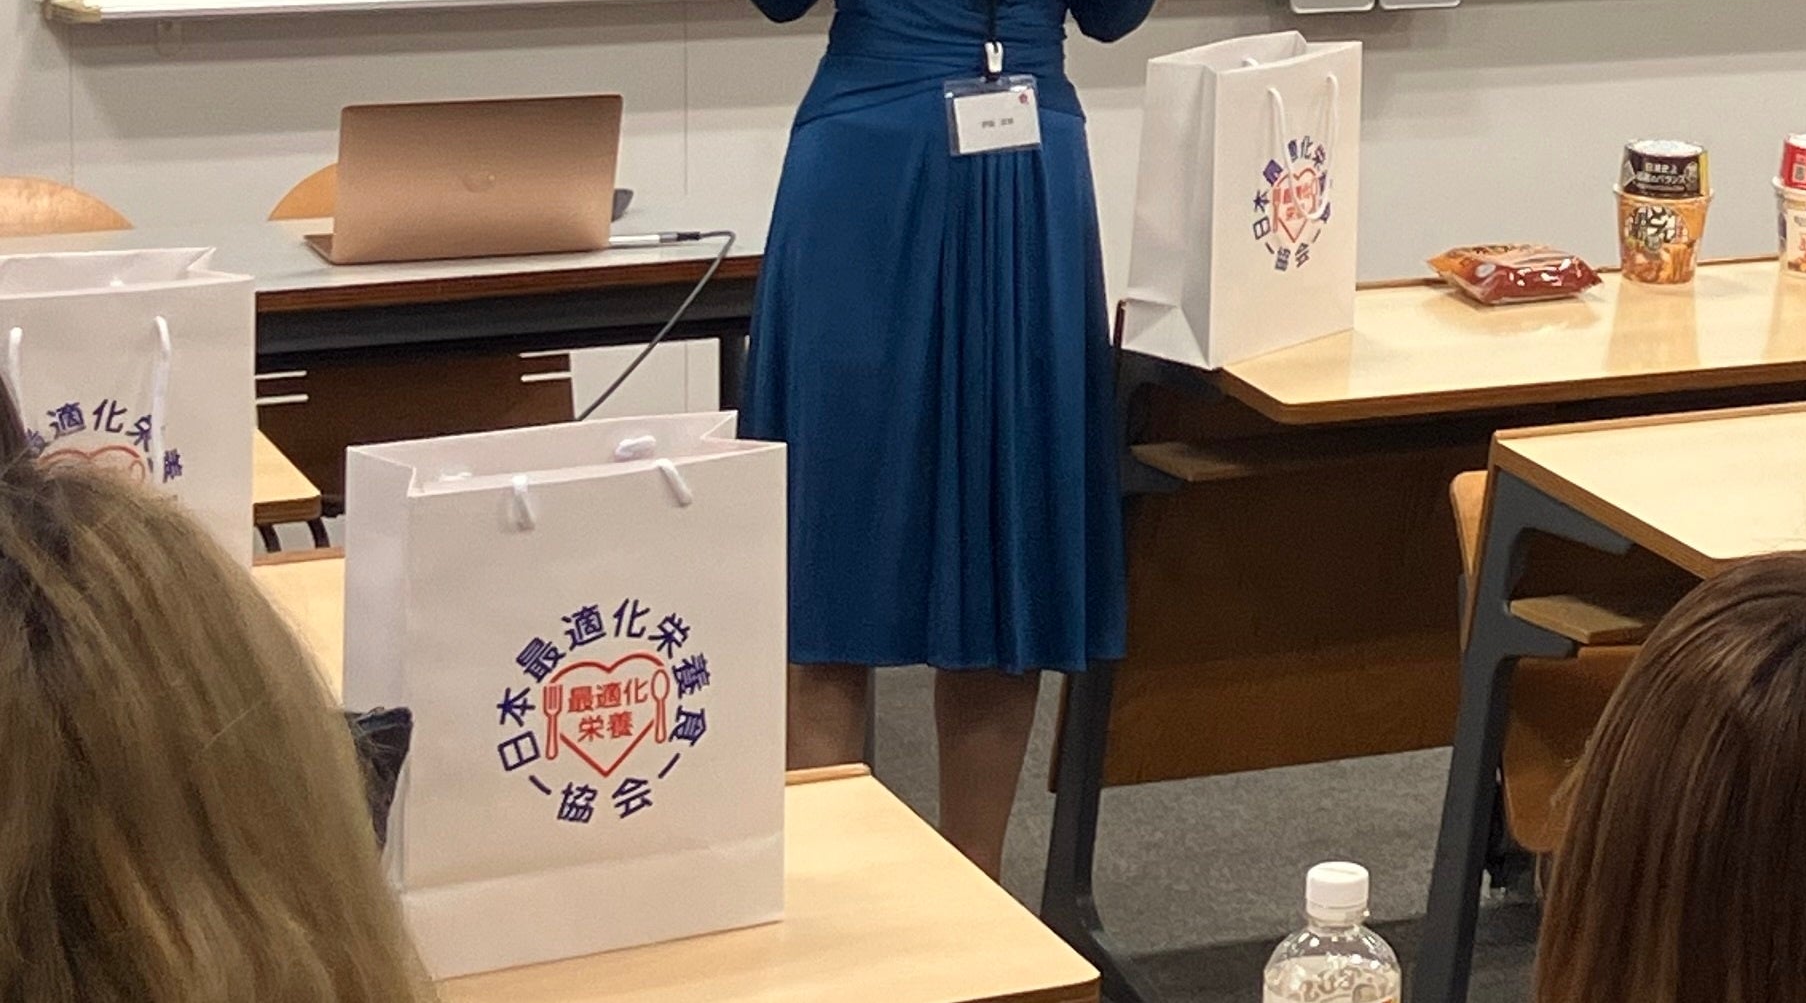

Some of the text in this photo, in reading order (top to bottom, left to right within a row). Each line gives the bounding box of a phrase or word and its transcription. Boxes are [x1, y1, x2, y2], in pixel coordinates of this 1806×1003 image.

[567, 678, 650, 714] 最適化
[578, 710, 635, 744] 栄養
